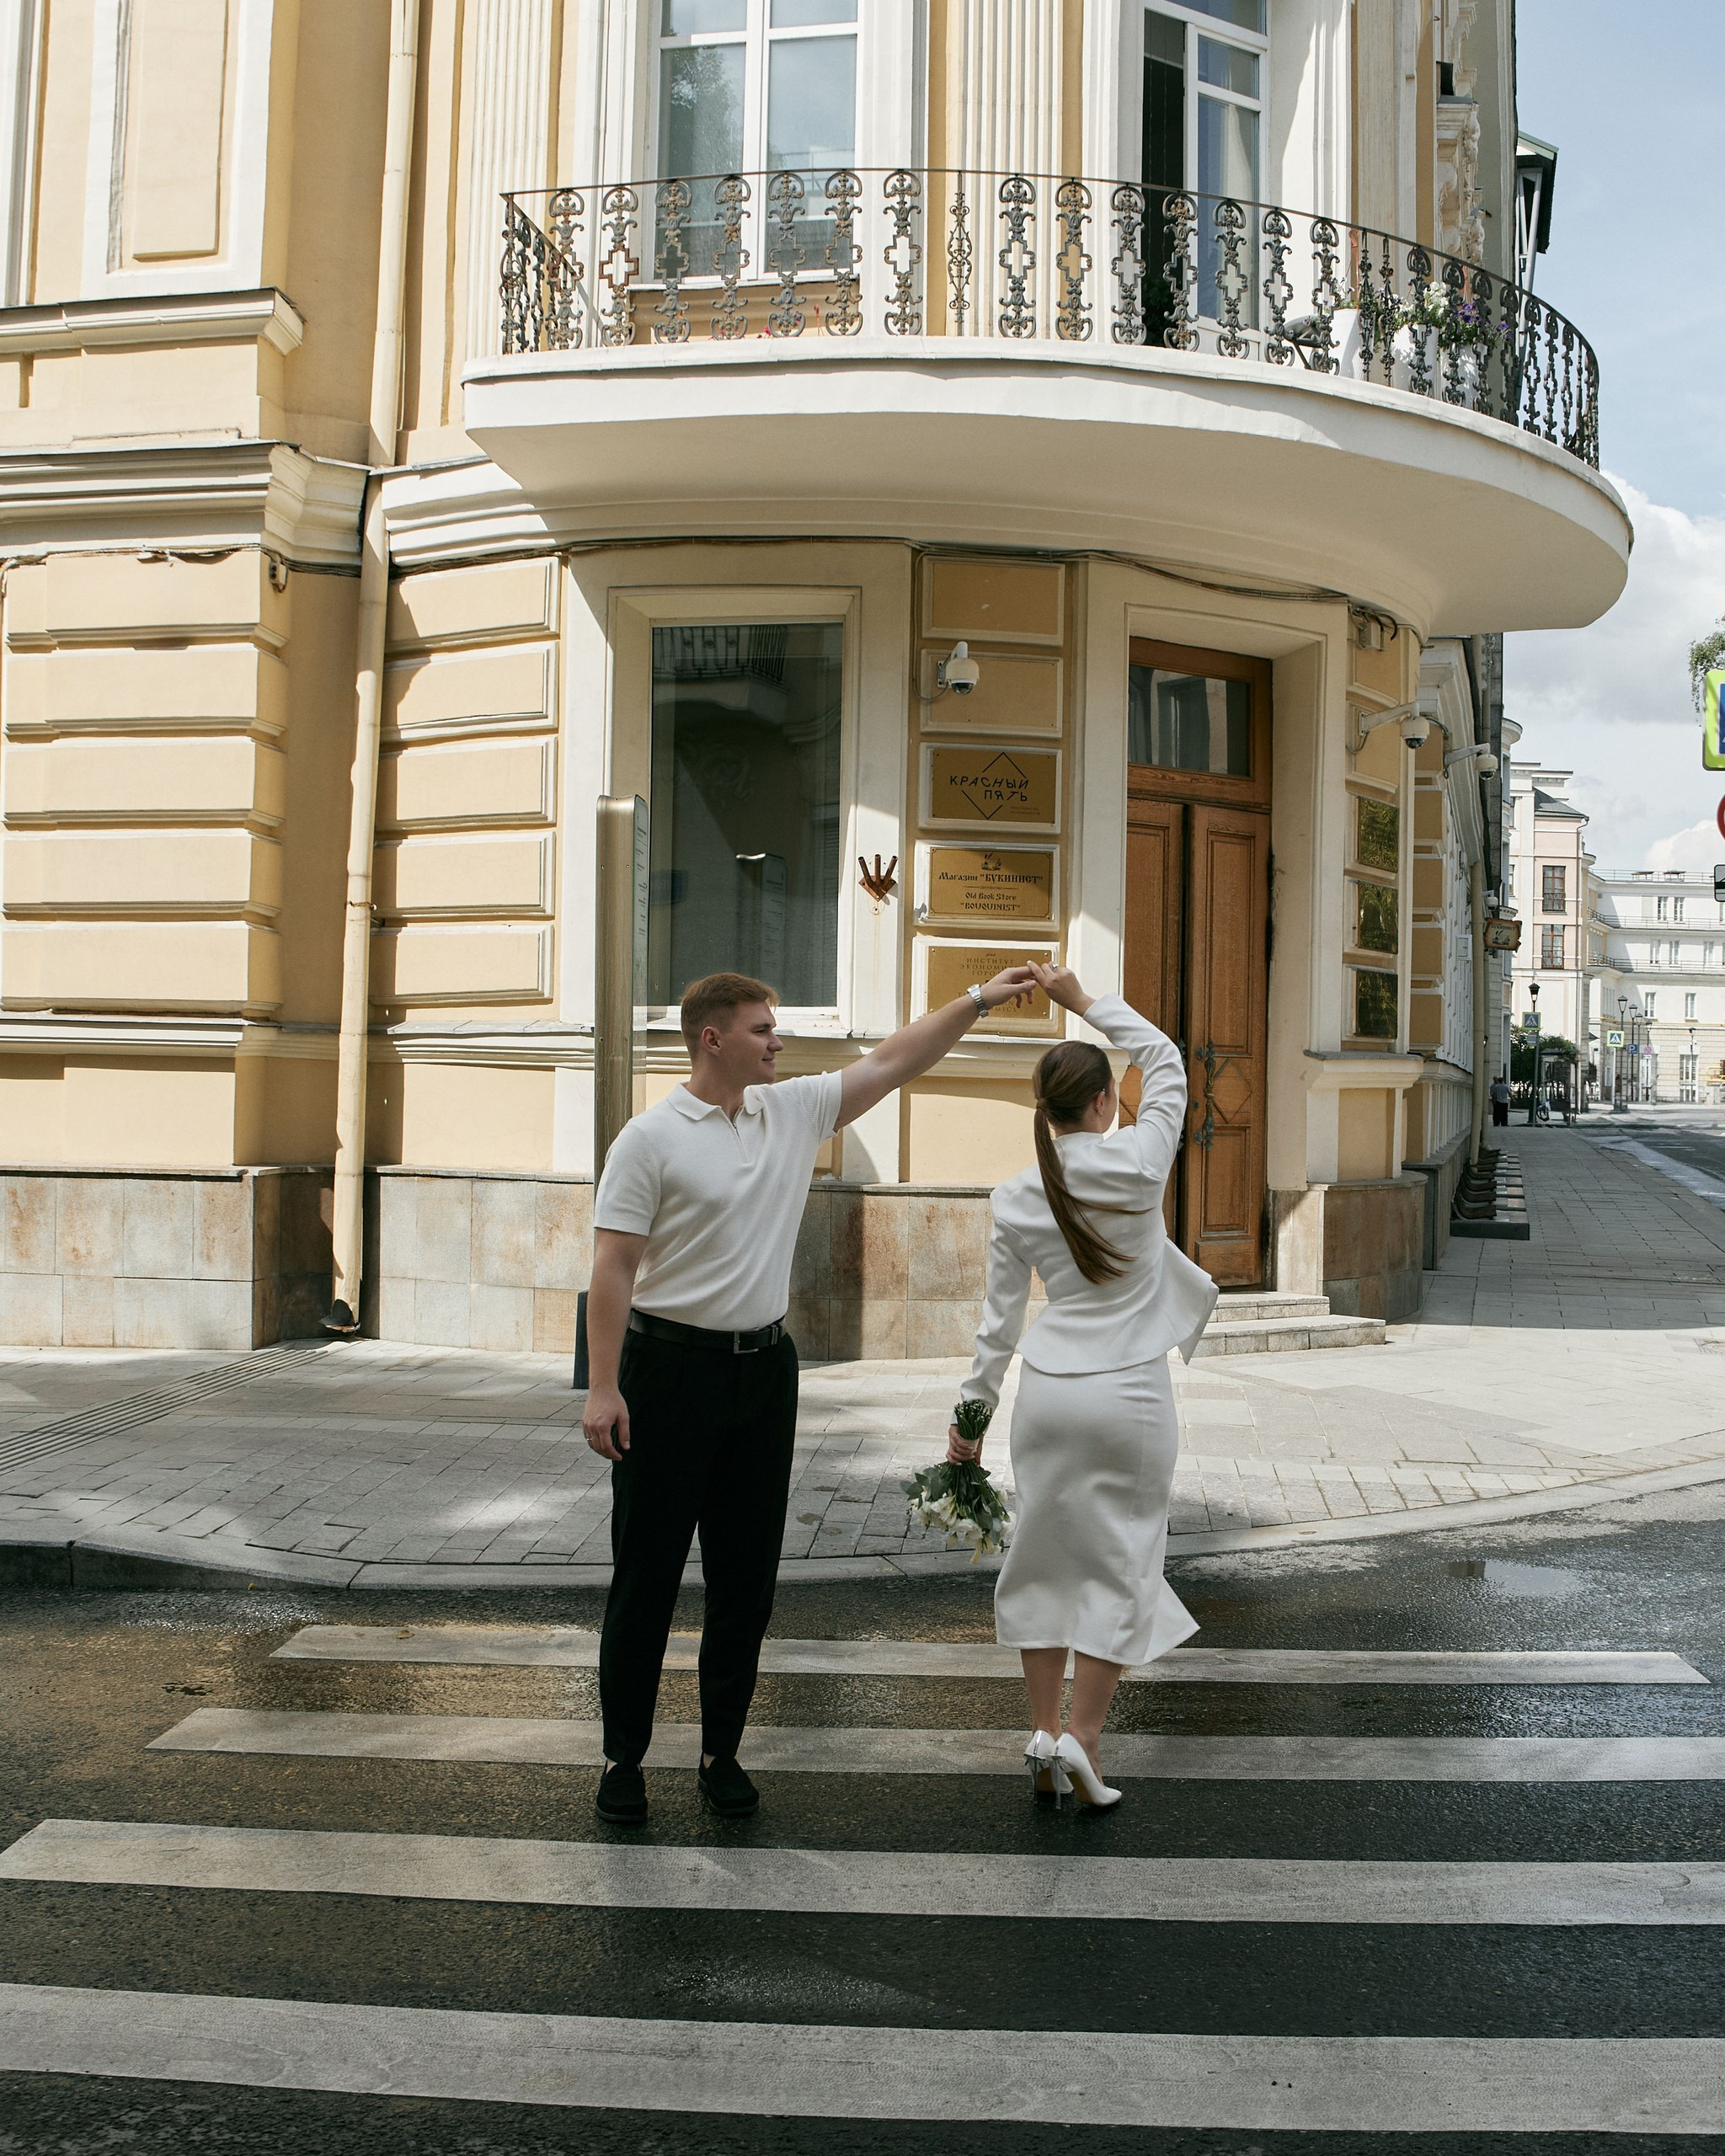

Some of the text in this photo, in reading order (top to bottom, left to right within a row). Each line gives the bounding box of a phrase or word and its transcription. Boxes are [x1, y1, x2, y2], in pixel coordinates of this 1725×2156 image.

[984, 789, 1028, 802] ПЯТЬ
[938, 872, 1044, 884] Магазин "БУКИНИСТ"
[960, 902, 1021, 911] "BOUQUINIST"
